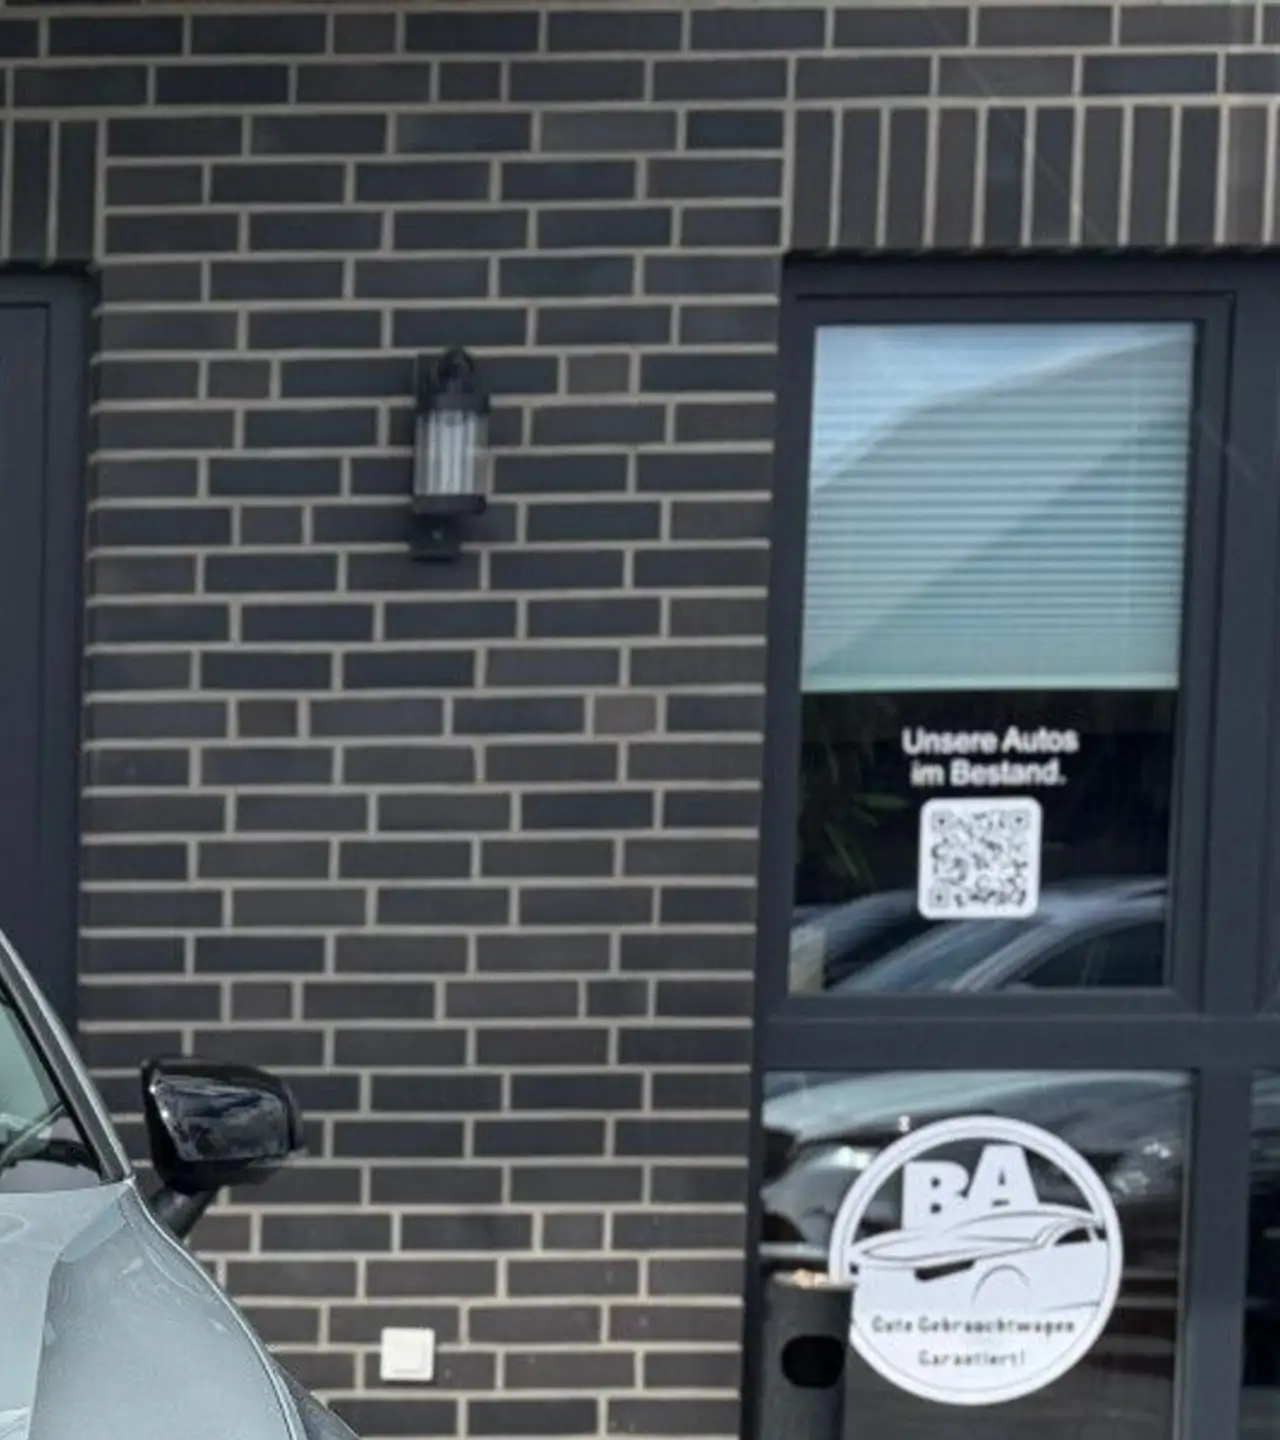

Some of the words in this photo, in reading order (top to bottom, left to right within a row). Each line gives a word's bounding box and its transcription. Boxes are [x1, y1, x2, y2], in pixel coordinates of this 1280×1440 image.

[901, 726, 999, 755] Unsere
[1001, 726, 1080, 753] Autos
[910, 758, 945, 786] im
[950, 757, 1068, 787] Bestand.
[902, 1144, 1040, 1231] BA
